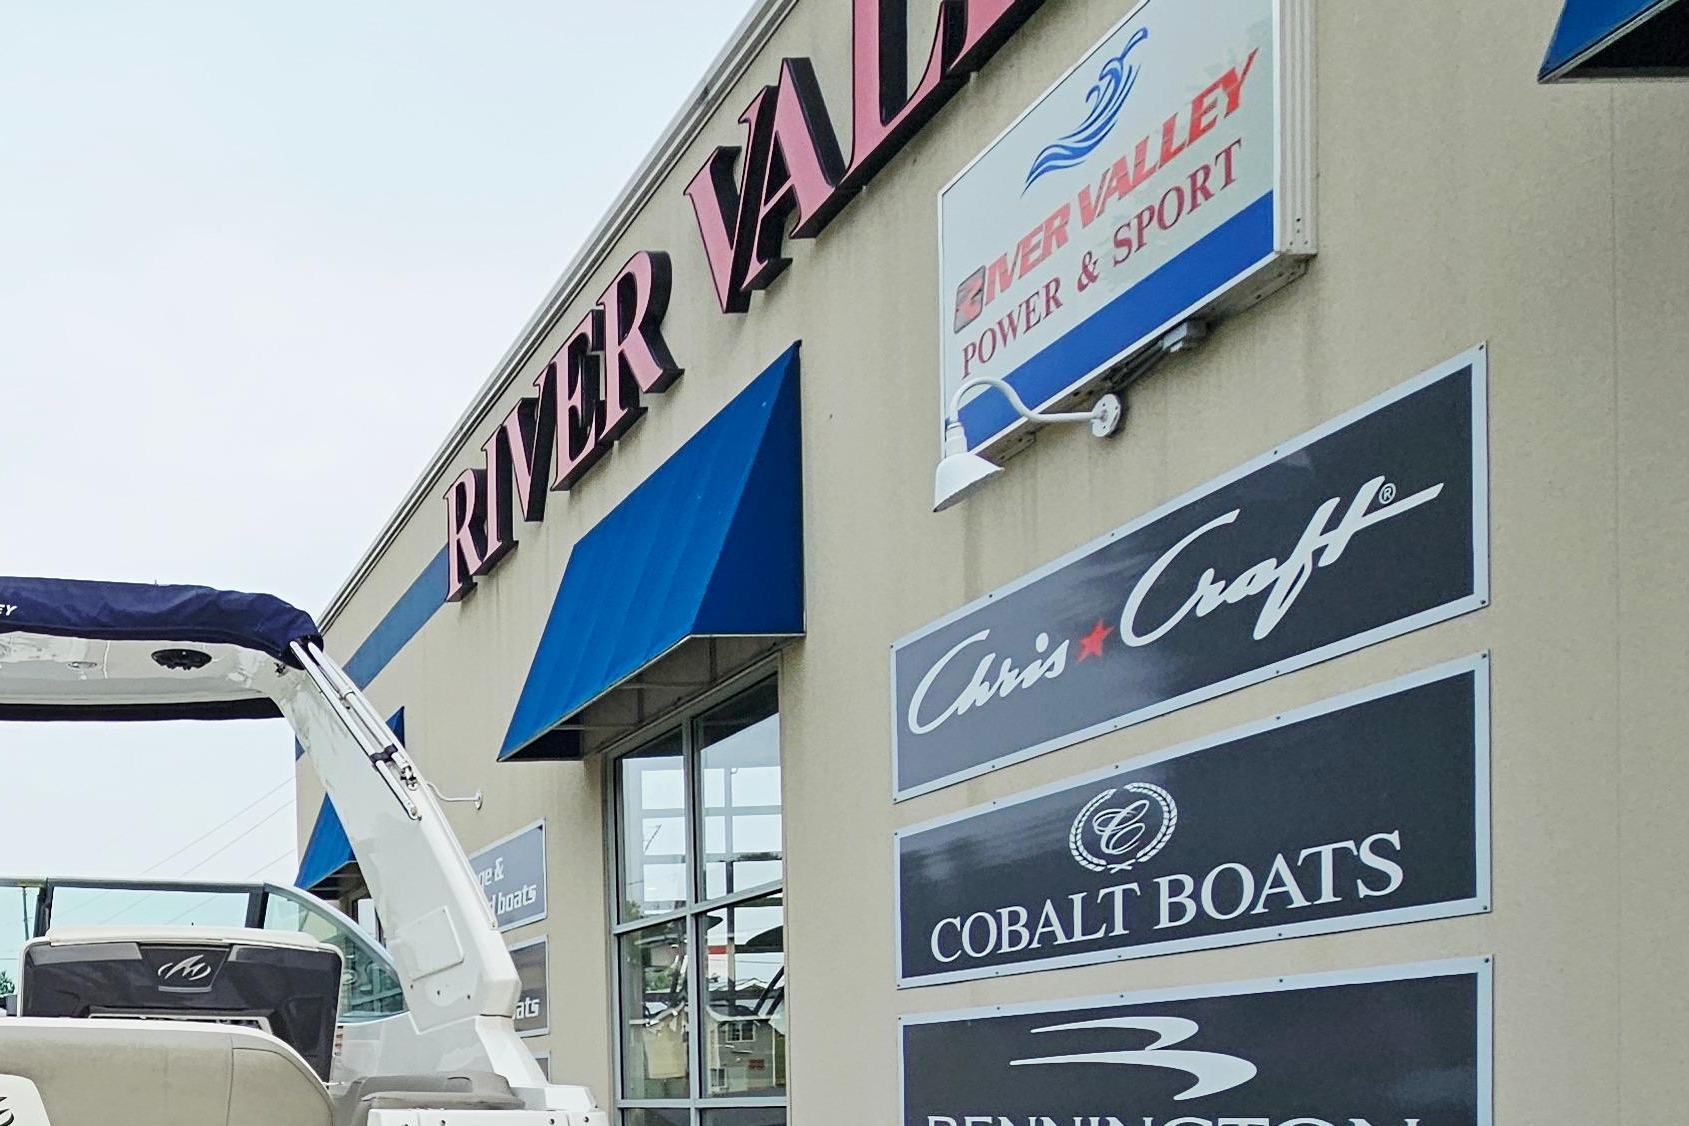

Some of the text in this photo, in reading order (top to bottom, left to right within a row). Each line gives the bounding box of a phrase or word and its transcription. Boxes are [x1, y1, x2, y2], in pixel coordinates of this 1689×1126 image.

[1076, 47, 1259, 230] VALLEY
[443, 0, 1046, 603] RIVER VAL
[961, 137, 1243, 381] POWER & SPORT
[908, 475, 1444, 735] Chris Craft
[497, 884, 537, 915] boats
[929, 830, 1405, 963] COBALT BOATS
